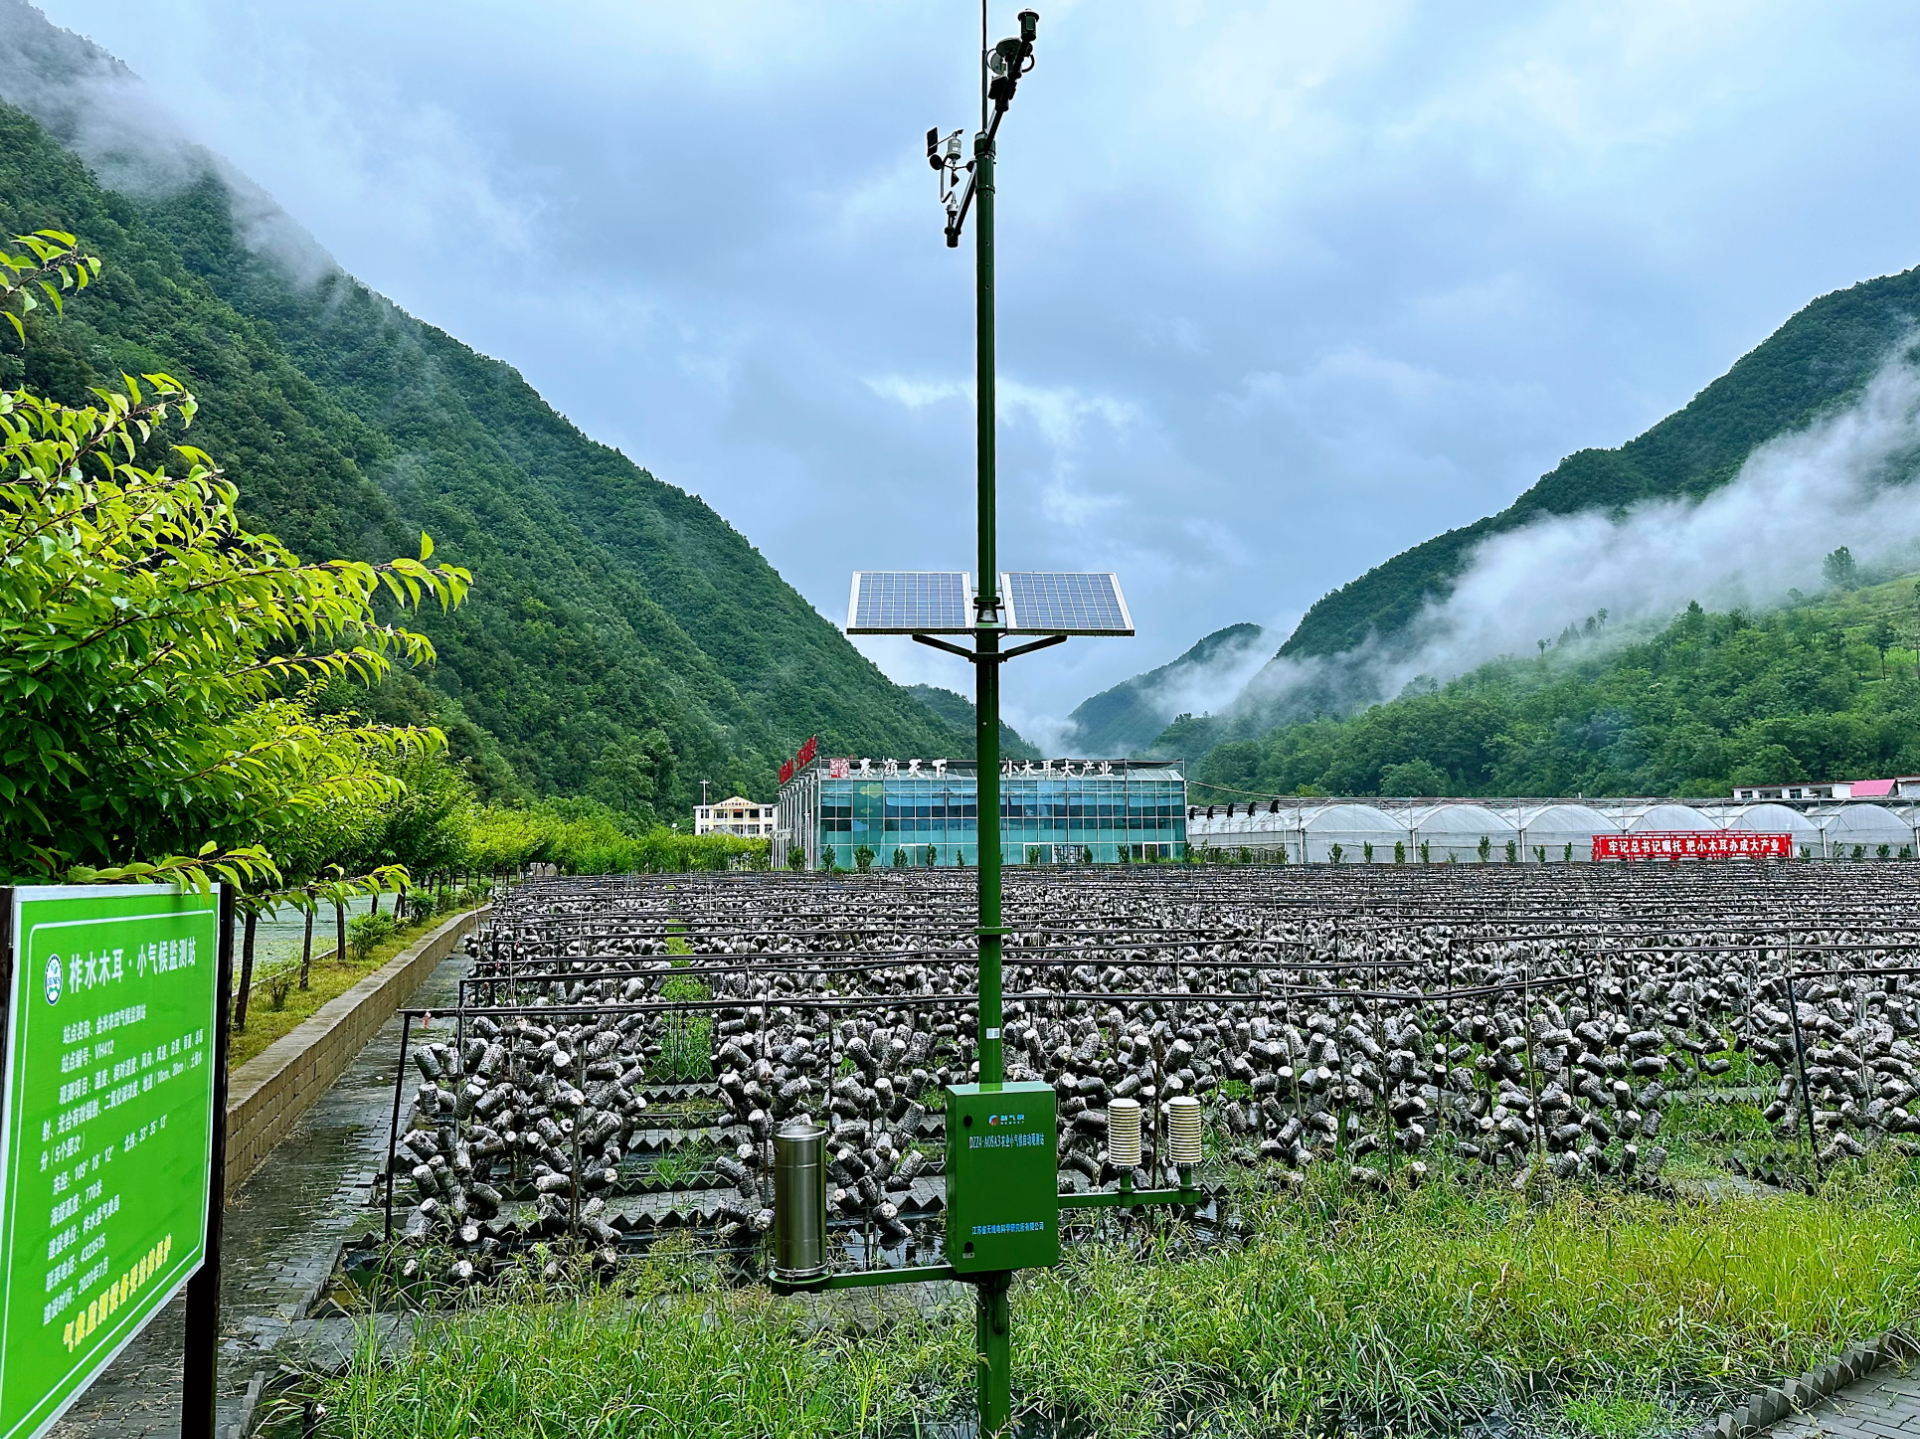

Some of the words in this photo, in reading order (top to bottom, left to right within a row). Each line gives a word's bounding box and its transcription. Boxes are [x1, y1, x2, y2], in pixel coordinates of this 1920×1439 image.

[1002, 759, 1115, 779] 小木耳大产业
[1608, 839, 1683, 854] 牢记总书记嘱托
[1686, 838, 1780, 853] 把小木耳办成大产业
